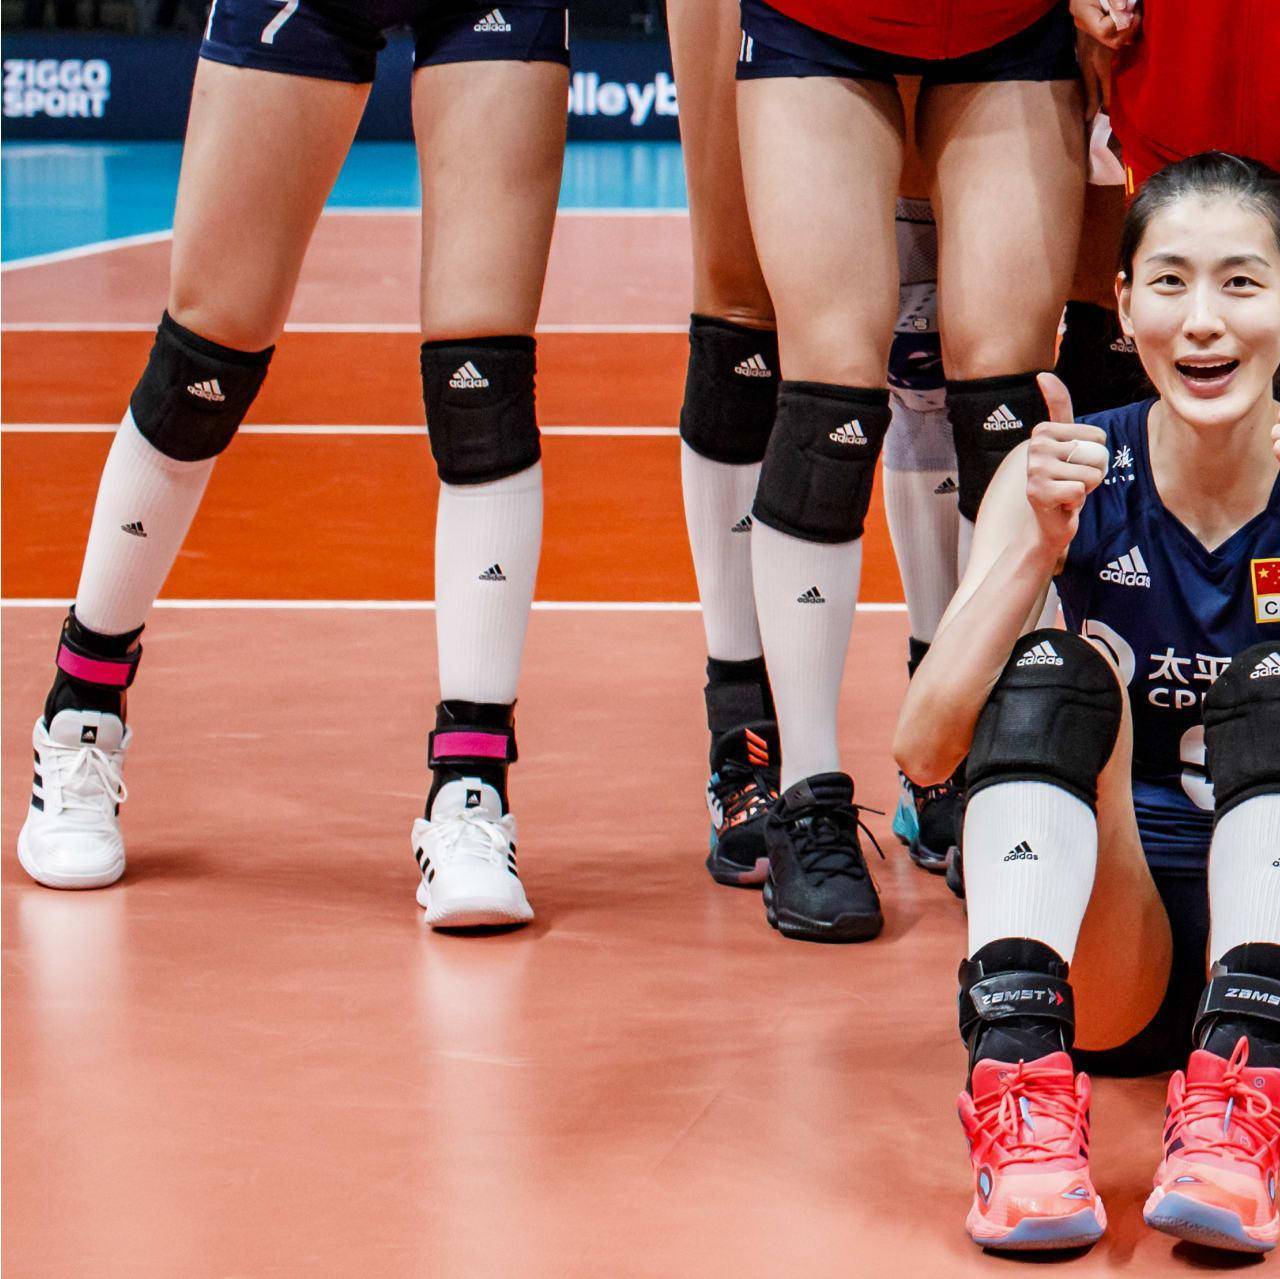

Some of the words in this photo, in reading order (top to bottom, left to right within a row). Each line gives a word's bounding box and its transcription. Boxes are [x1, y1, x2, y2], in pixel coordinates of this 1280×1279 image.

[473, 23, 512, 33] adidas
[2, 59, 111, 88] ZIGGO
[2, 87, 107, 118] SPORT
[735, 365, 771, 377] adidas
[449, 377, 489, 389] adidas
[187, 383, 226, 402] adidas
[982, 418, 1023, 431] adidas
[828, 431, 868, 445] adidas
[1112, 444, 1134, 469] 旗
[1099, 567, 1151, 589] adidas
[1015, 655, 1064, 667] adidas
[1003, 851, 1039, 863] adidas
